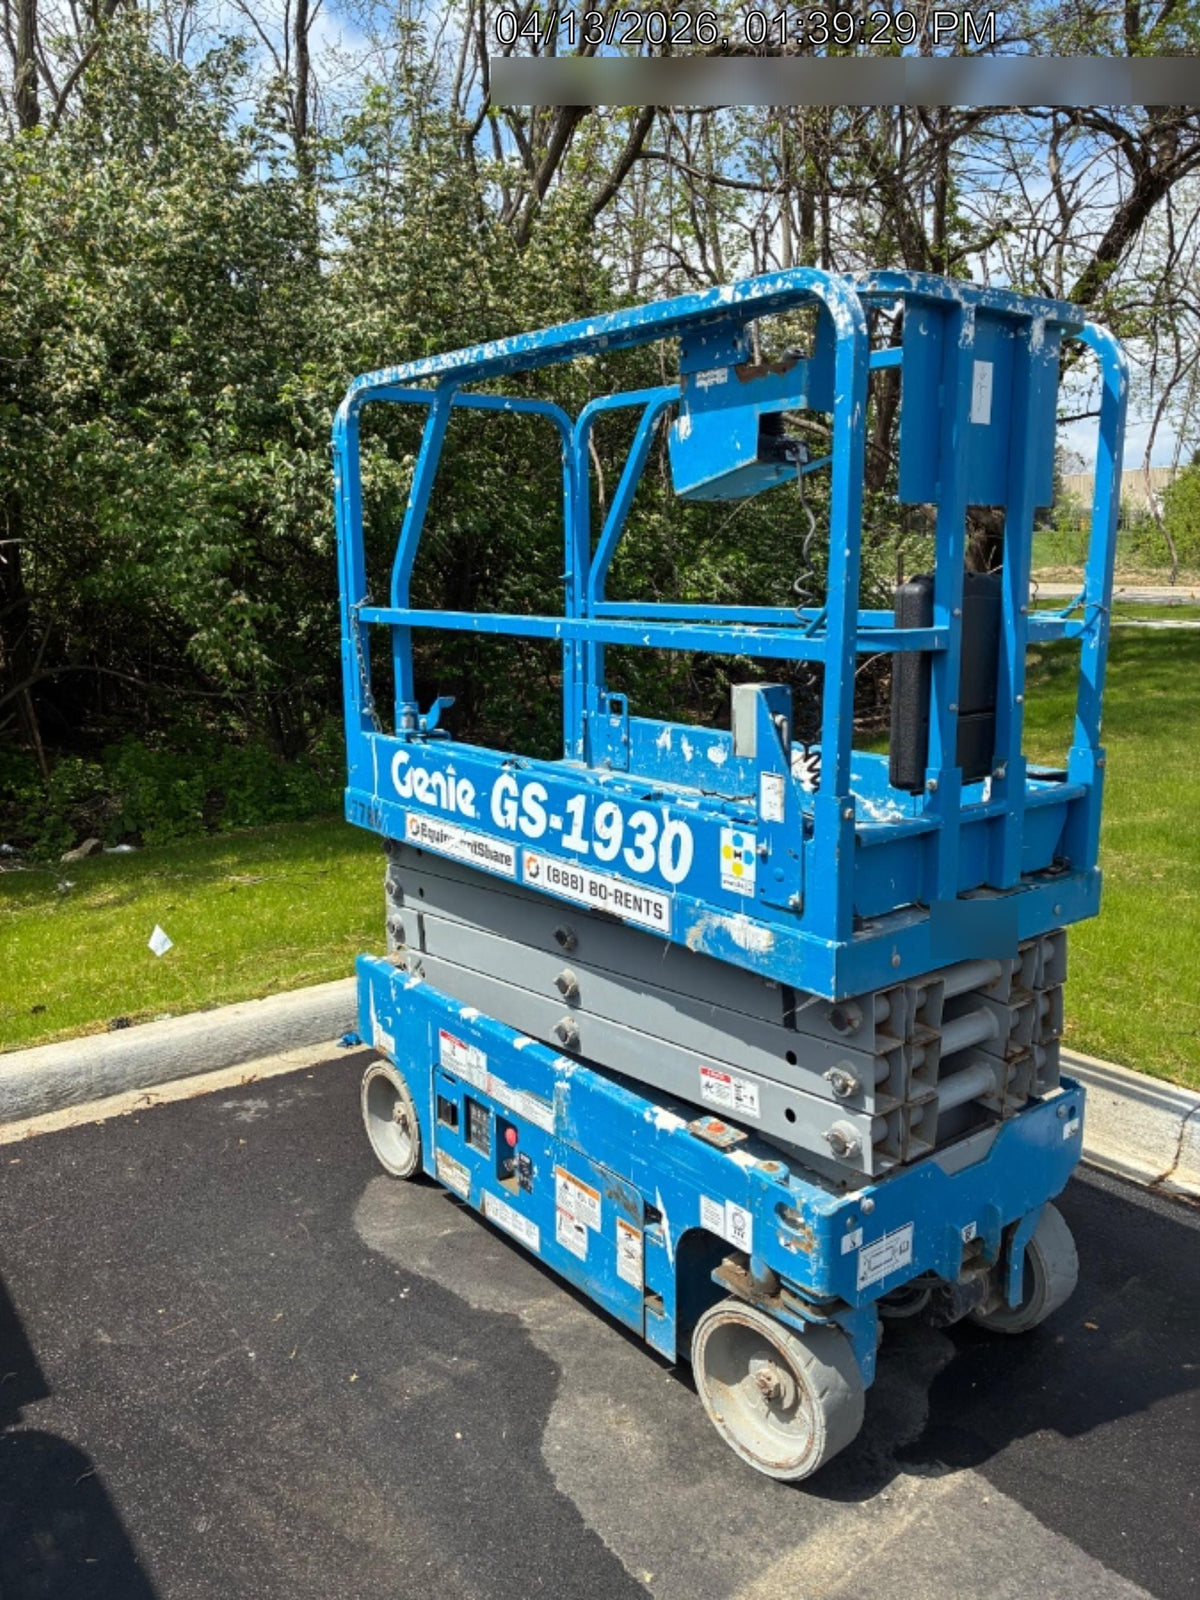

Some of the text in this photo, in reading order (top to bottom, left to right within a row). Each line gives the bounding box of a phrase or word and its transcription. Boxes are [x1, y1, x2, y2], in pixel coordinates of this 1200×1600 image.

[391, 750, 477, 818] Genie
[490, 773, 694, 884] GS-1930
[547, 865, 584, 893] (888)
